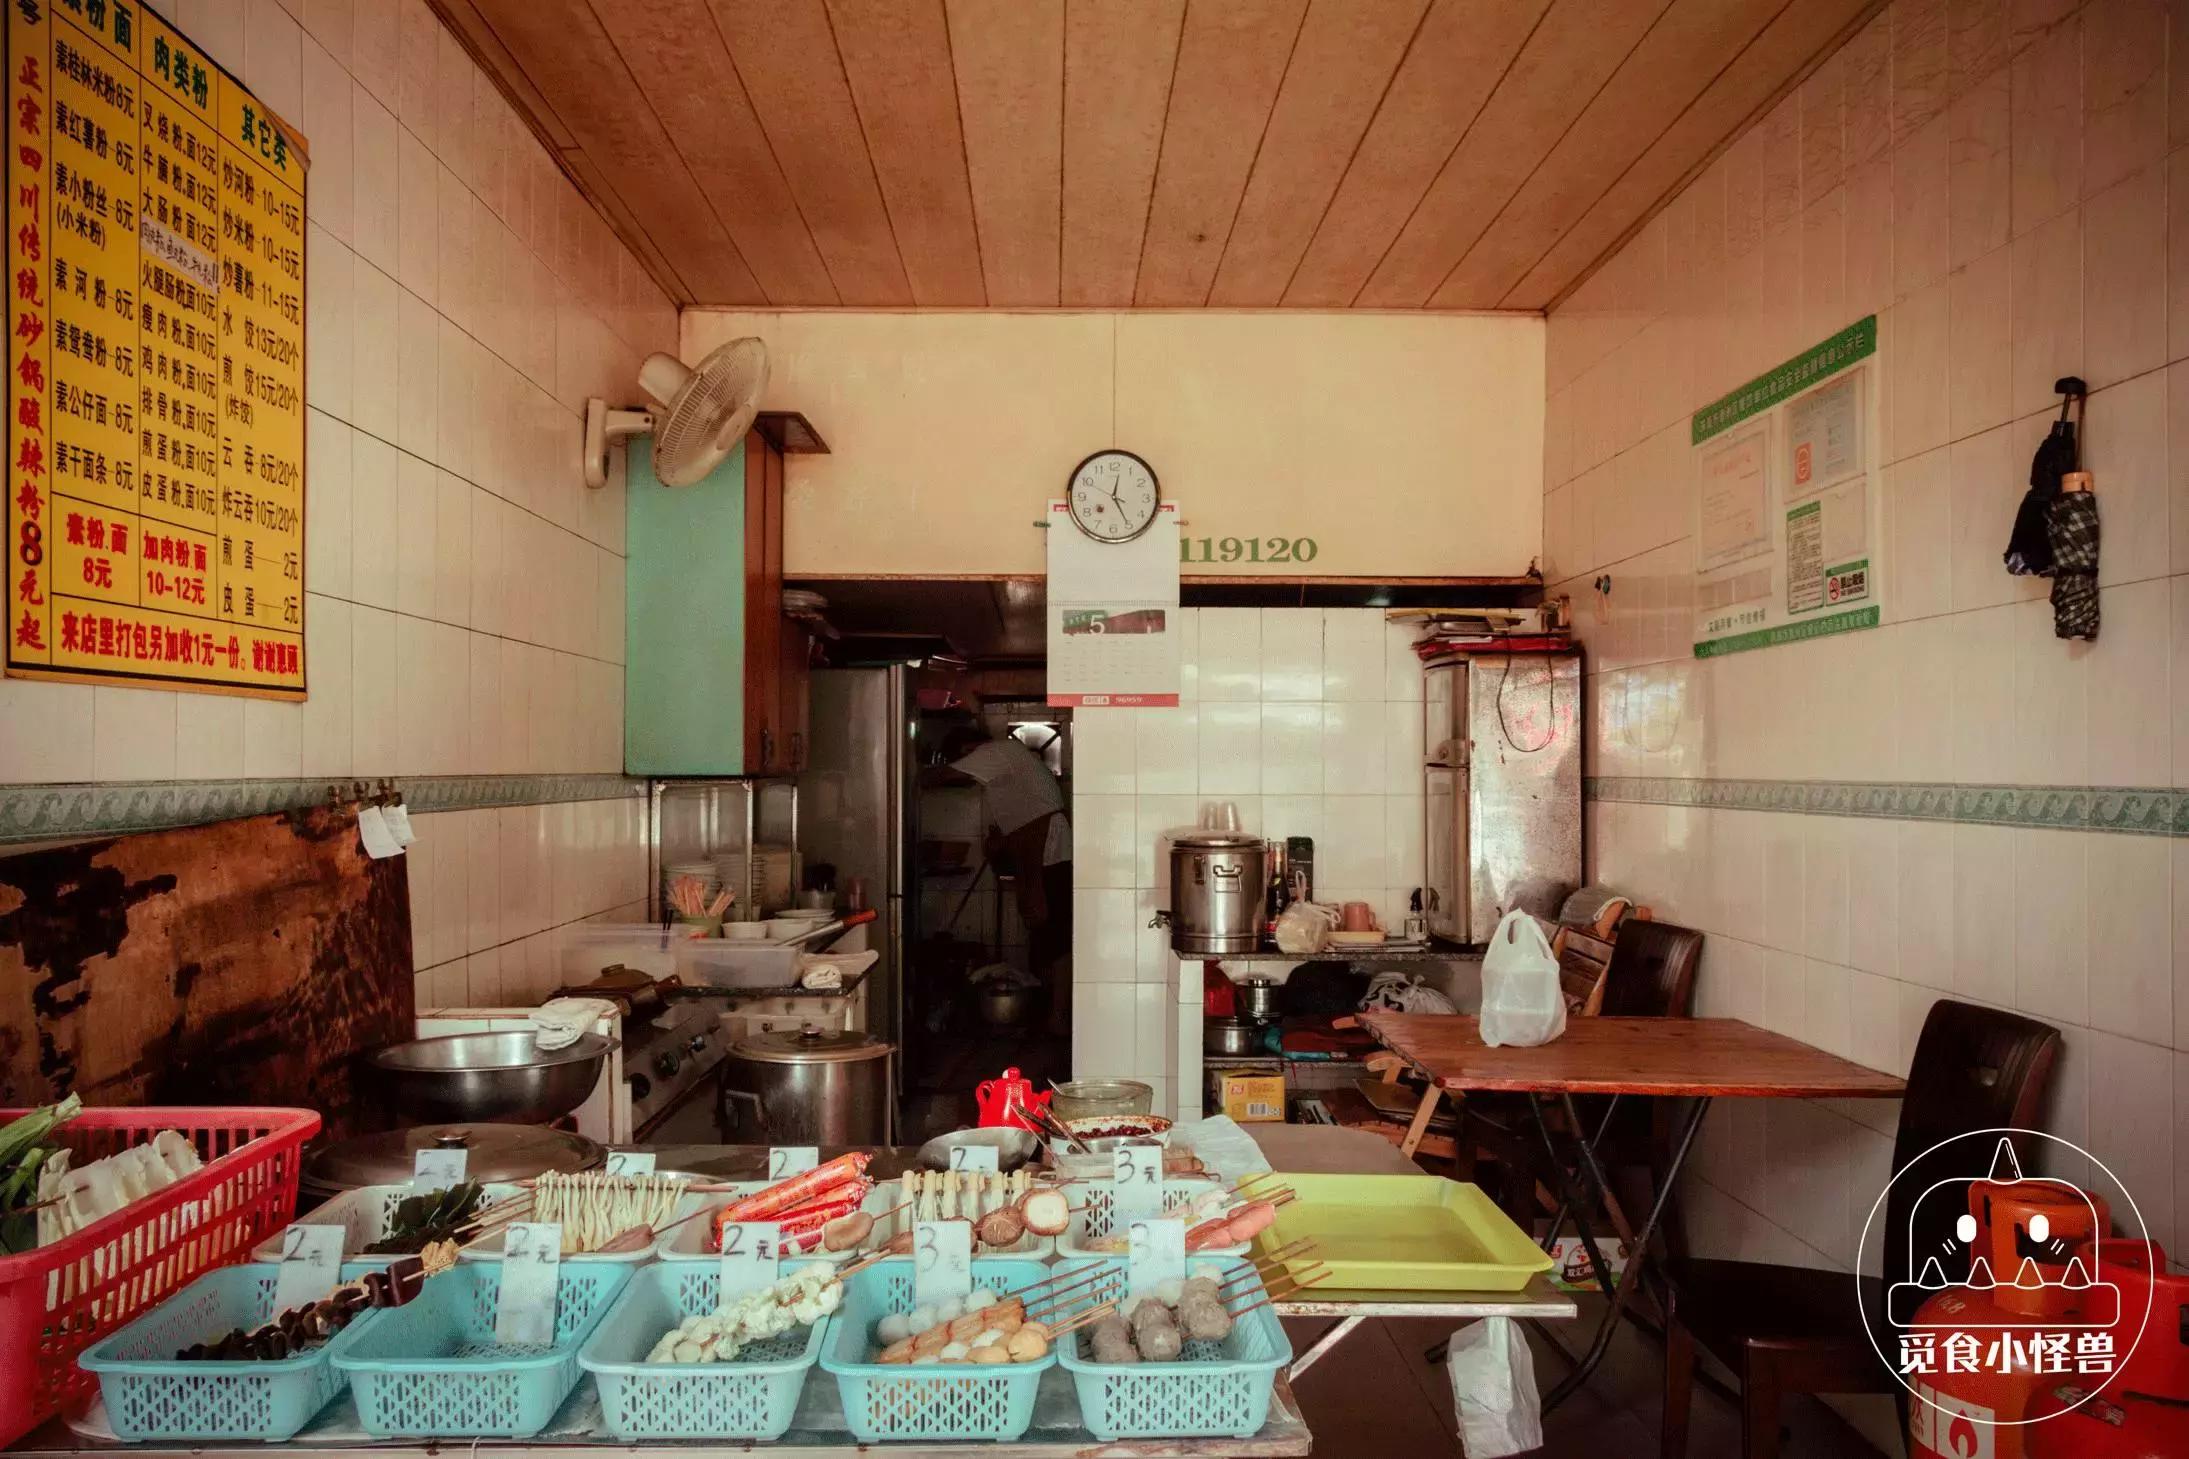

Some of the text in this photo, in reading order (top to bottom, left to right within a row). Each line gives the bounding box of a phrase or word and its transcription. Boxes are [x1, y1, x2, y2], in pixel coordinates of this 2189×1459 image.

[55, 39, 134, 118] 素桂林米粉8元
[154, 35, 208, 110] 肉类粉
[241, 103, 287, 172] 其它类
[1094, 465, 1104, 475] 11
[1109, 462, 1121, 472] 12
[1129, 465, 1133, 476] 1
[1082, 477, 1094, 487] 10
[1136, 478, 1146, 488] 2
[1077, 492, 1087, 502] 9
[1142, 493, 1151, 504] 3
[1083, 507, 1092, 518] 8
[1137, 509, 1145, 521] 4
[1095, 520, 1102, 530] 7
[1109, 523, 1118, 534] 6
[1124, 520, 1134, 530] 5
[1179, 537, 1318, 563] 119120
[83, 557, 112, 589] 8元
[147, 570, 205, 605] 10-12元
[1089, 614, 1105, 635] 5
[1118, 1150, 1156, 1184] 3元
[283, 1227, 323, 1267] 2元
[507, 1226, 557, 1264] 2元
[723, 1225, 774, 1261] 2元
